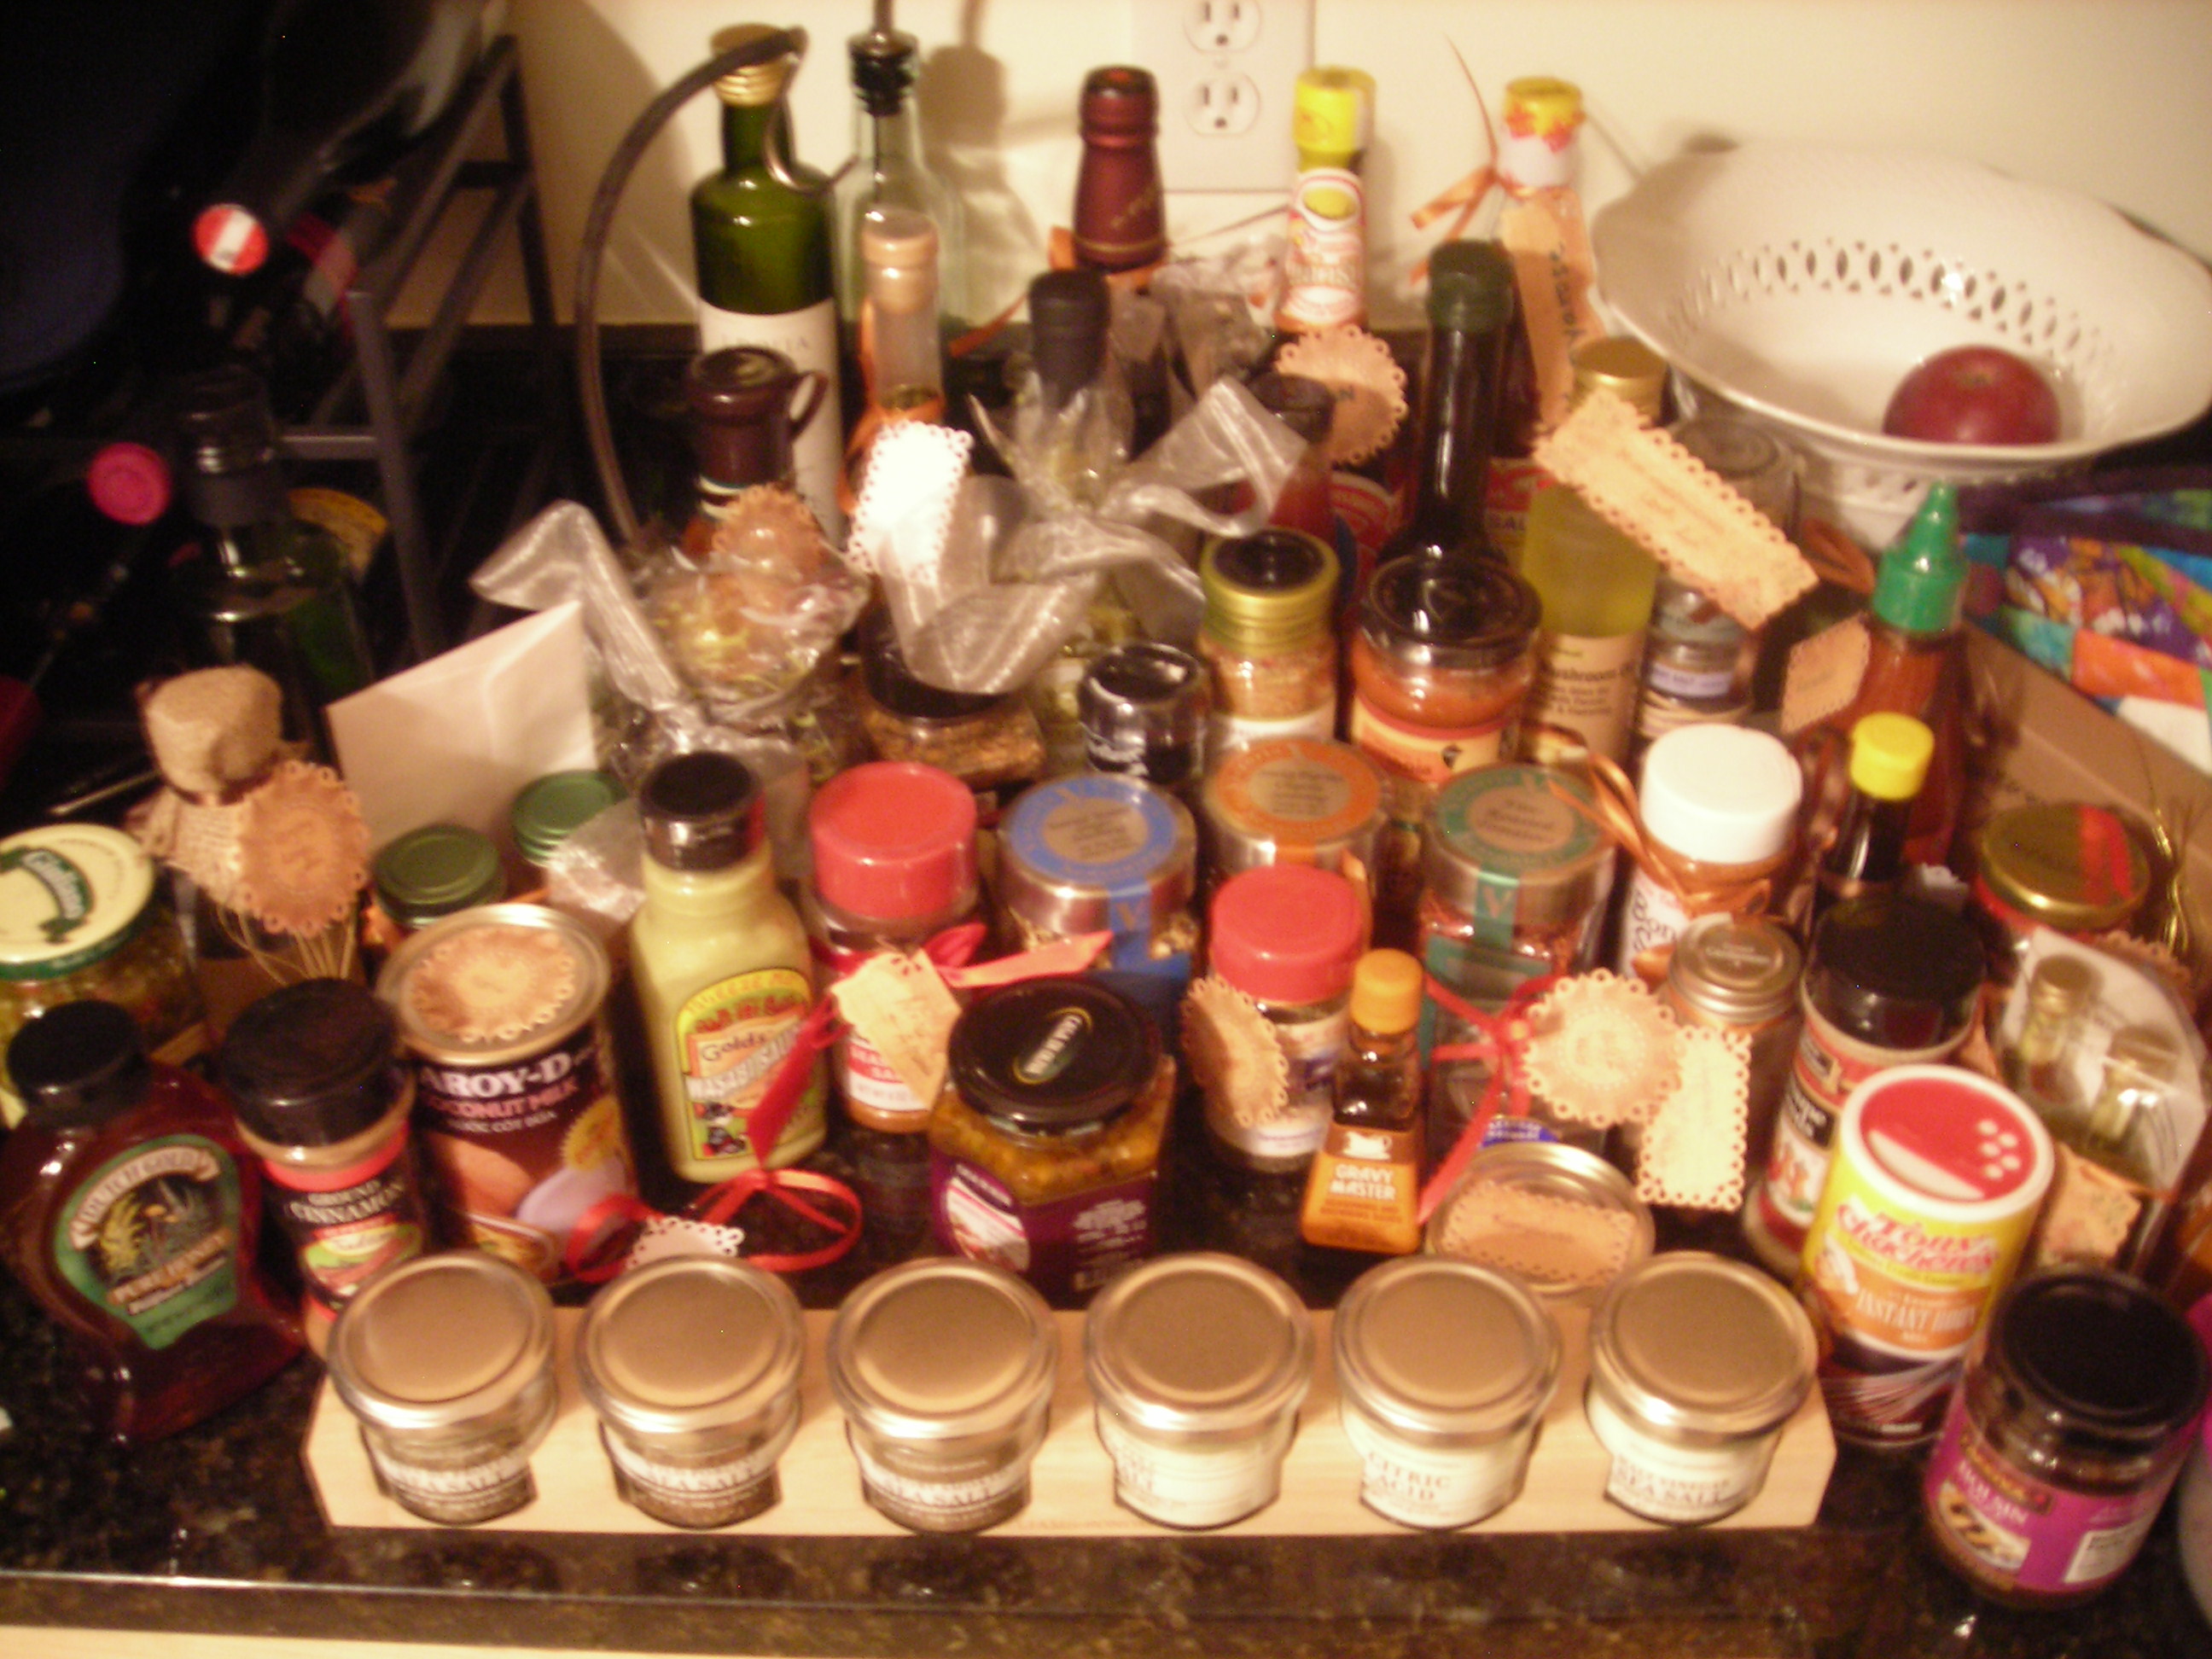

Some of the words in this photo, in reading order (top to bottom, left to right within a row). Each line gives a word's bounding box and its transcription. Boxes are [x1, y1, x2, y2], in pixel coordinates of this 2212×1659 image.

[422, 1052, 573, 1098] AROY-D
[1335, 1164, 1394, 1184] GRAVY
[1329, 1180, 1396, 1202] MASTER
[1368, 1452, 1451, 1490] CITRIC
[1376, 1474, 1436, 1501] ACID
